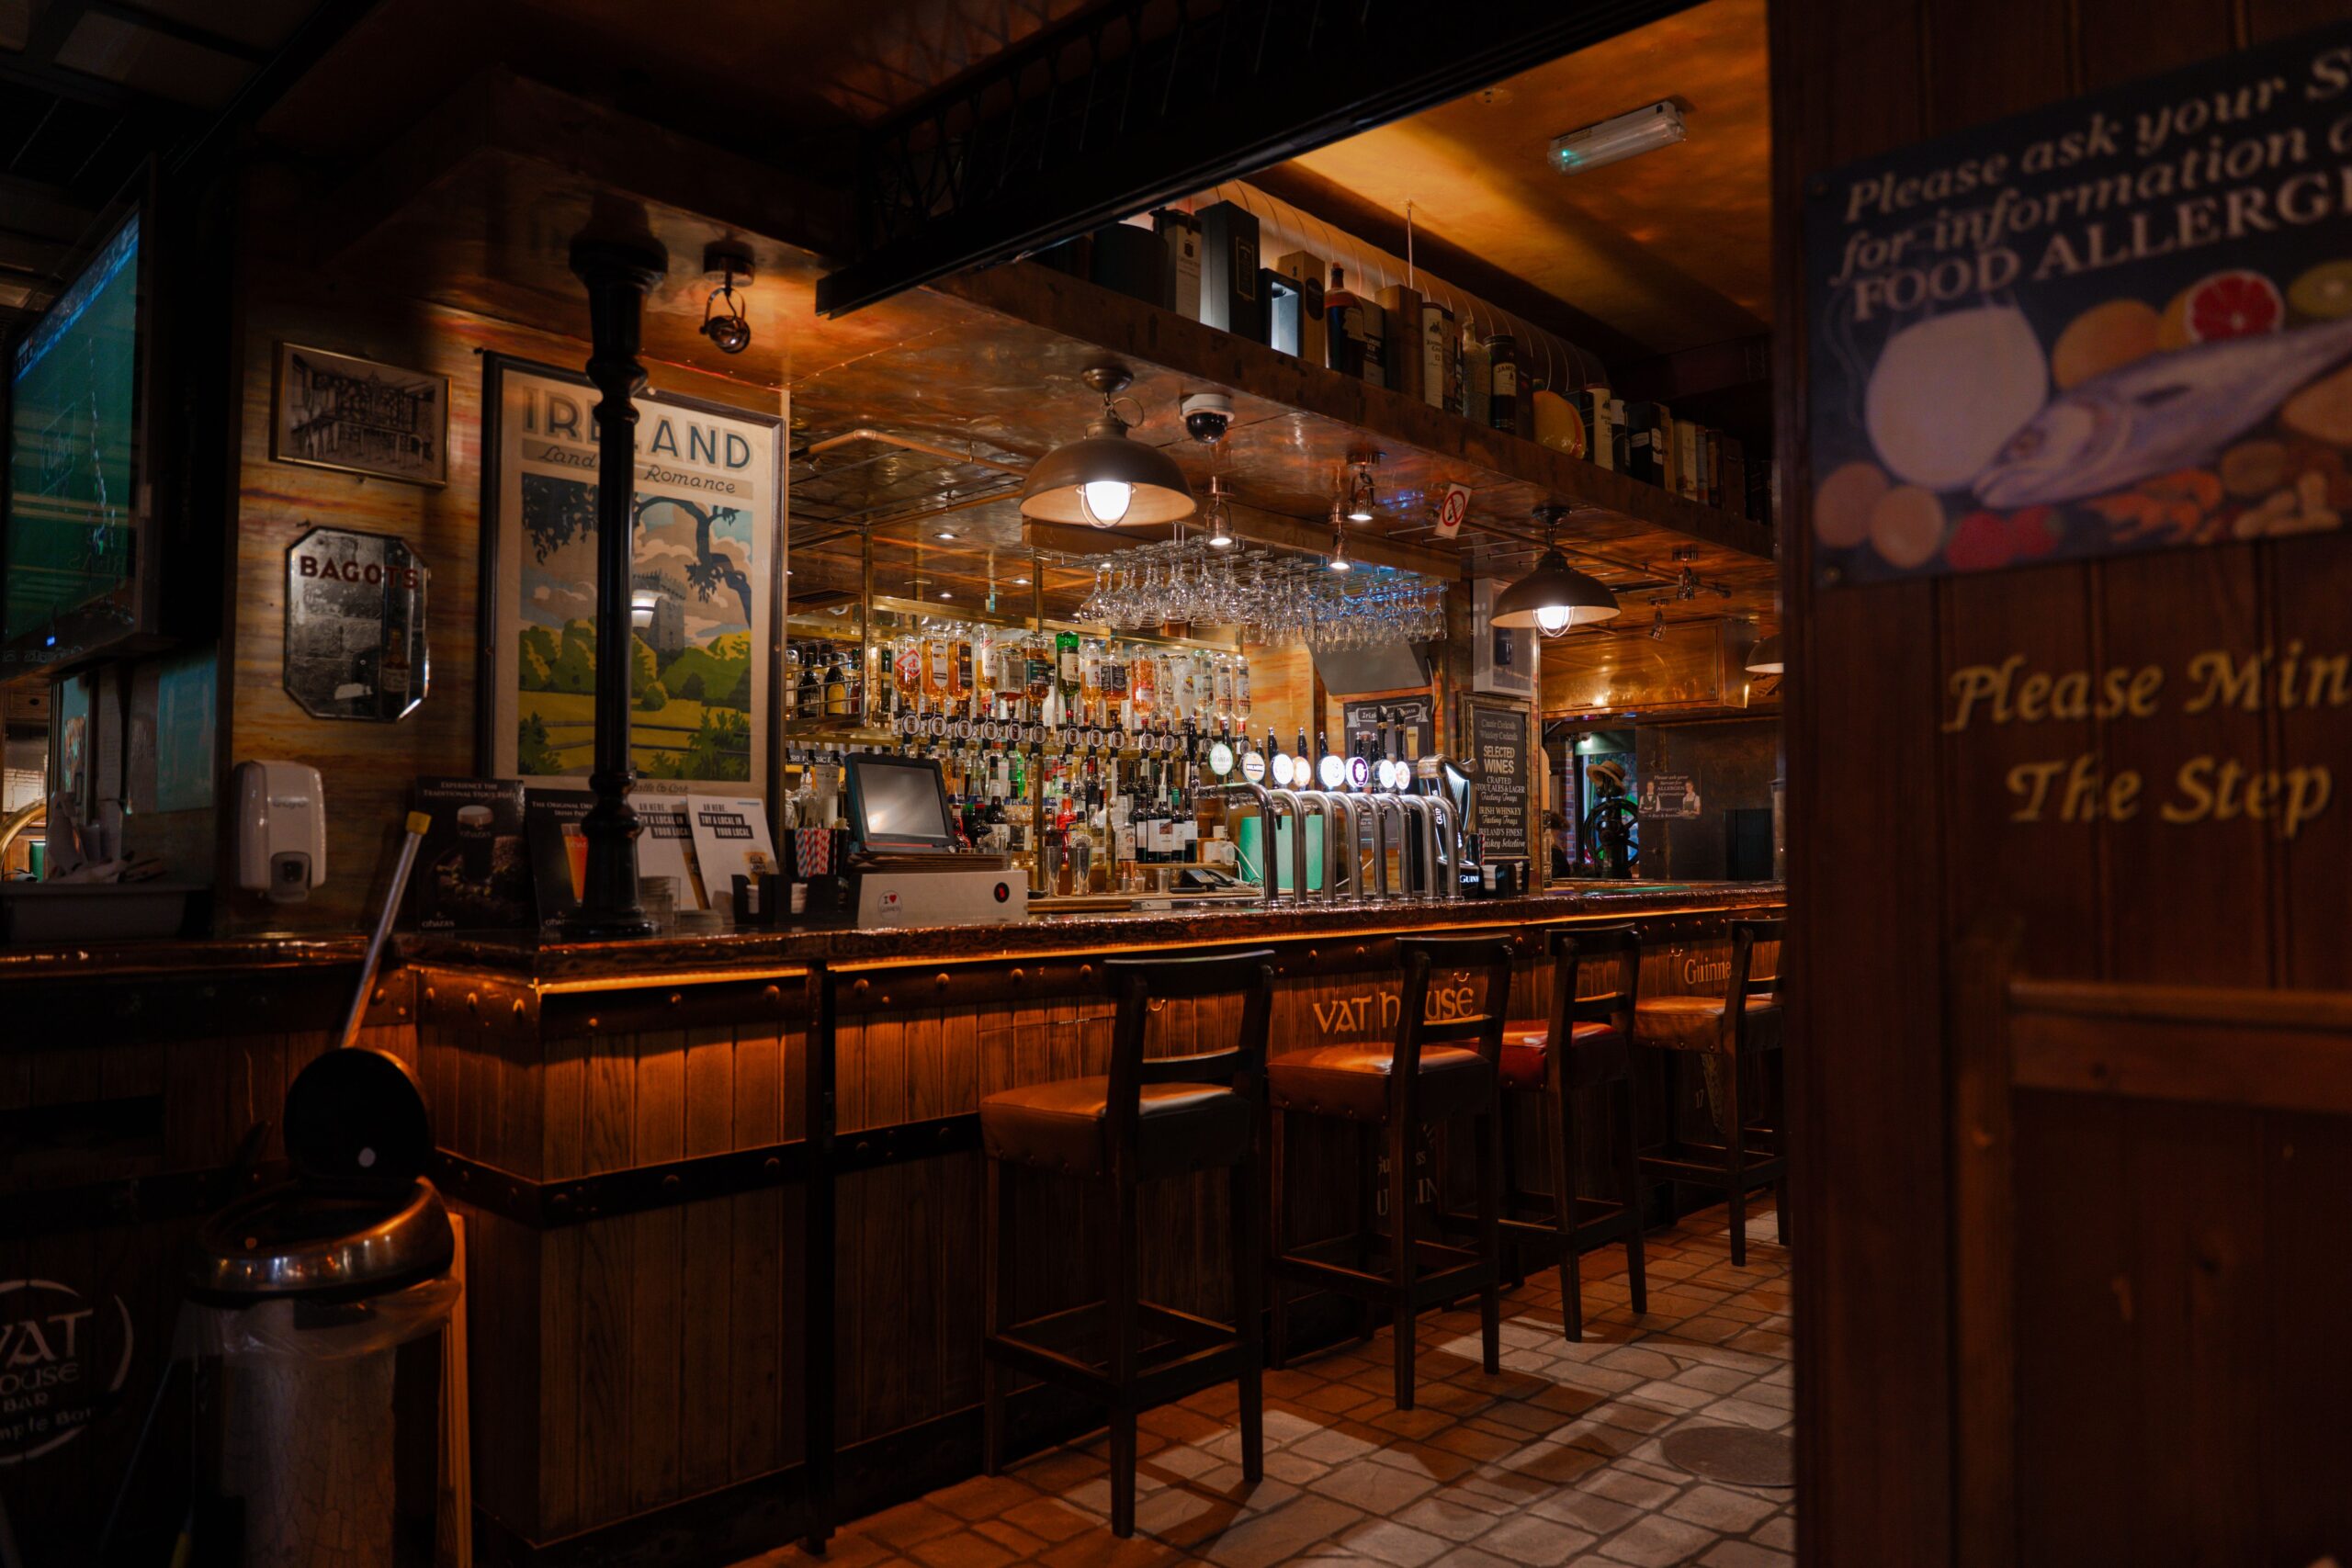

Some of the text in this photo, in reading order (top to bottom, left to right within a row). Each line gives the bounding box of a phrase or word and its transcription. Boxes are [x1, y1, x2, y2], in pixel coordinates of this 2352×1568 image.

[1843, 150, 2010, 225] Please
[2021, 111, 2123, 175] ask
[2134, 74, 2288, 158] your
[1827, 230, 1917, 288] for
[1933, 125, 2310, 254] information
[1852, 245, 2021, 322] FOOD
[539, 445, 737, 494] Land Romance
[300, 555, 419, 591] BAGOTS
[1939, 652, 2165, 735] Please
[1484, 745, 1515, 758] SELECTED
[1484, 759, 1514, 774] WINES
[1487, 775, 1512, 784] CRAFTED
[1509, 785, 1525, 794] LAGER
[2005, 752, 2333, 840] The Step
[718, 815, 735, 825] LOCAL
[735, 816, 742, 825] IN
[1478, 806, 1522, 817] IRISH WHISKEY
[732, 828, 752, 838] LOCAL
[1505, 829, 1523, 837] FINEST
[1312, 993, 1373, 1034] VAT
[3, 1391, 51, 1414] BAR
